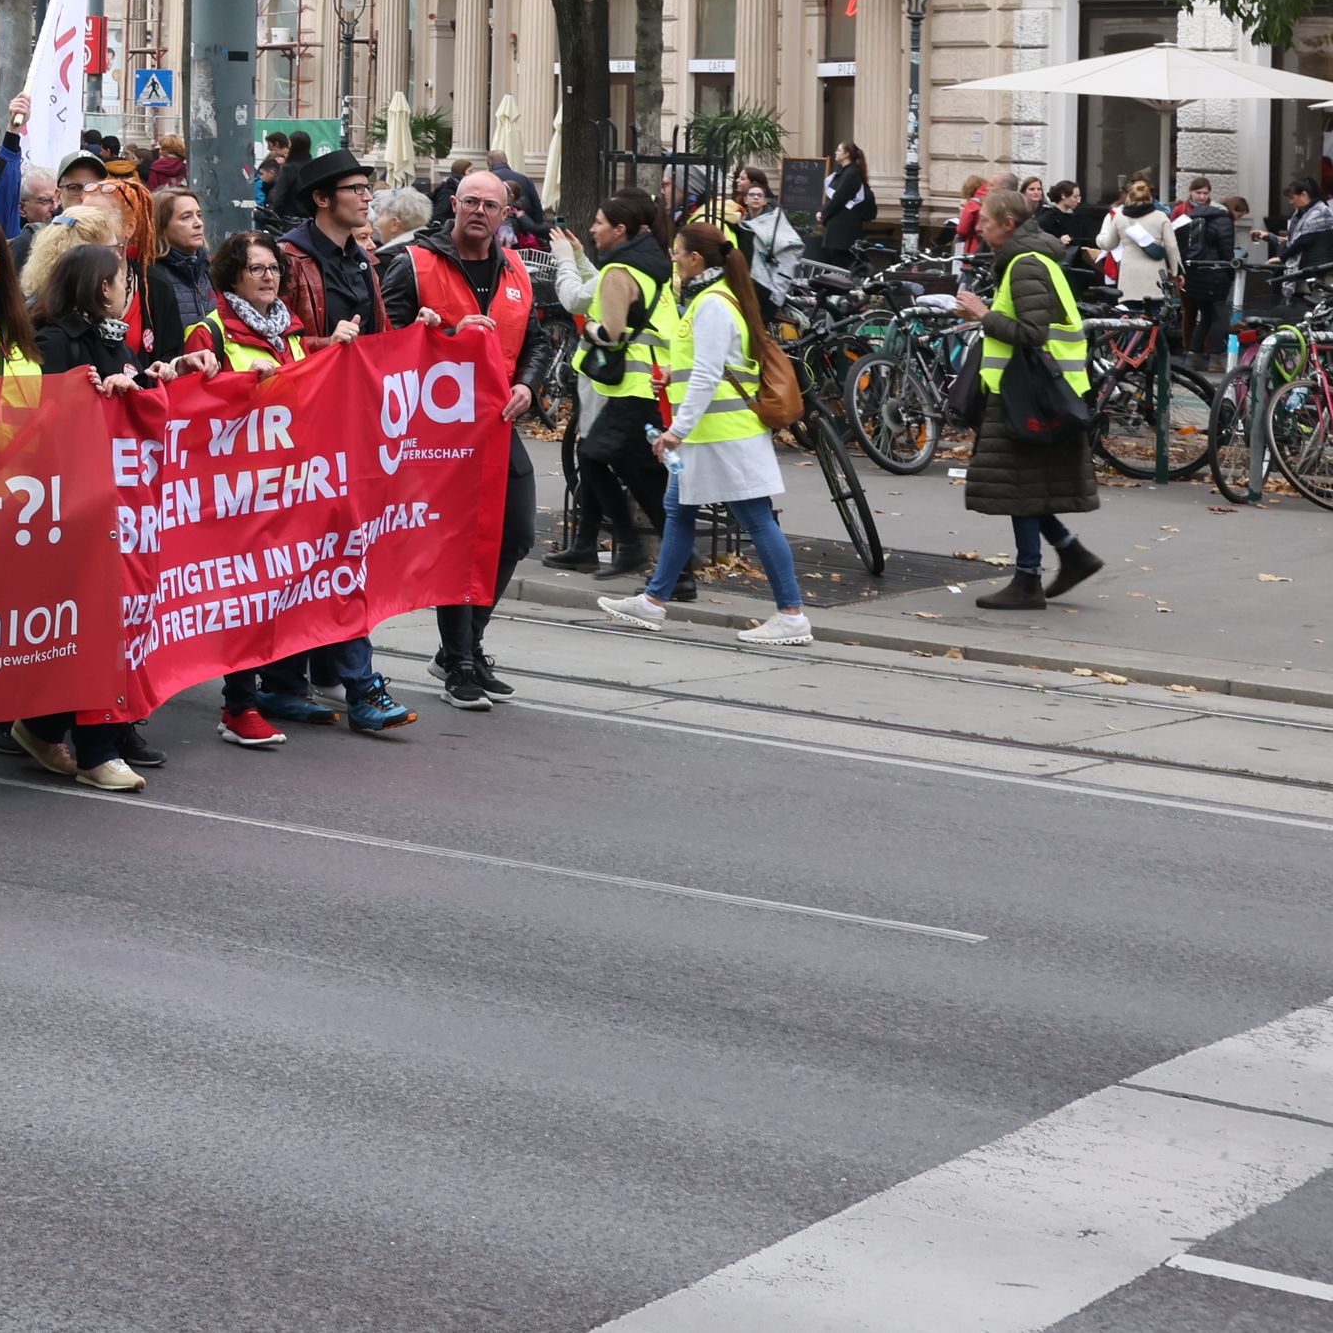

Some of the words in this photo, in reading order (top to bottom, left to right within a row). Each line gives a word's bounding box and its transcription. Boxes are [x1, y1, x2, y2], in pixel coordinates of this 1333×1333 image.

[208, 405, 294, 458] WIR
[213, 451, 349, 521] MEHR!
[263, 545, 294, 580] IN
